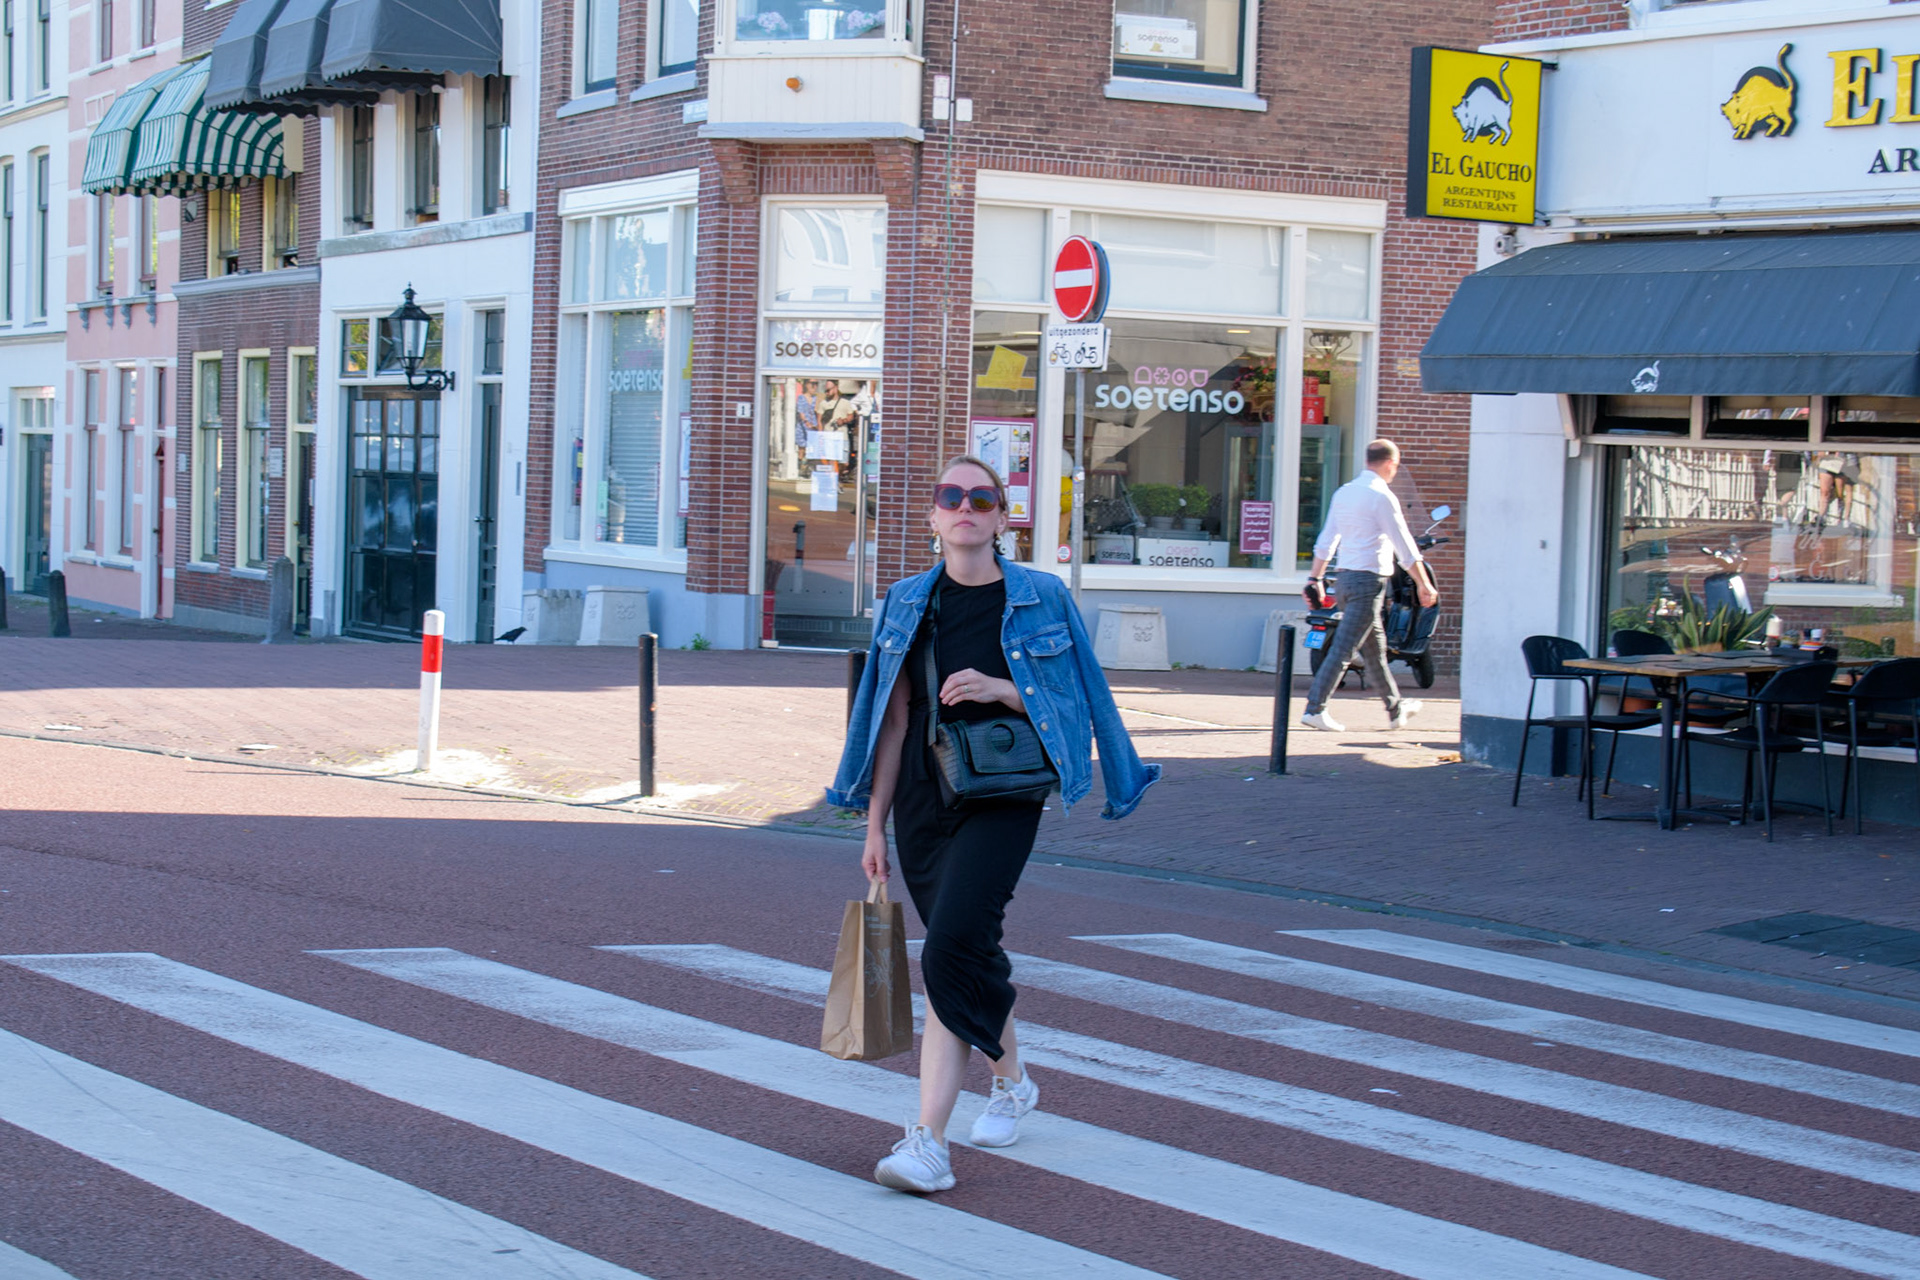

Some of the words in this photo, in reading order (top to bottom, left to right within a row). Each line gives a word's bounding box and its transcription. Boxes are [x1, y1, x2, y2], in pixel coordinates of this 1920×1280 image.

[1460, 154, 1532, 182] GAUCHO
[1445, 186, 1516, 201] ARGENTIJNS
[1442, 198, 1519, 212] RESTAURANT
[1049, 326, 1098, 338] uitgezonderd
[775, 341, 878, 359] soetenso
[1095, 384, 1245, 415] soetenso
[1149, 555, 1214, 568] soetenso
